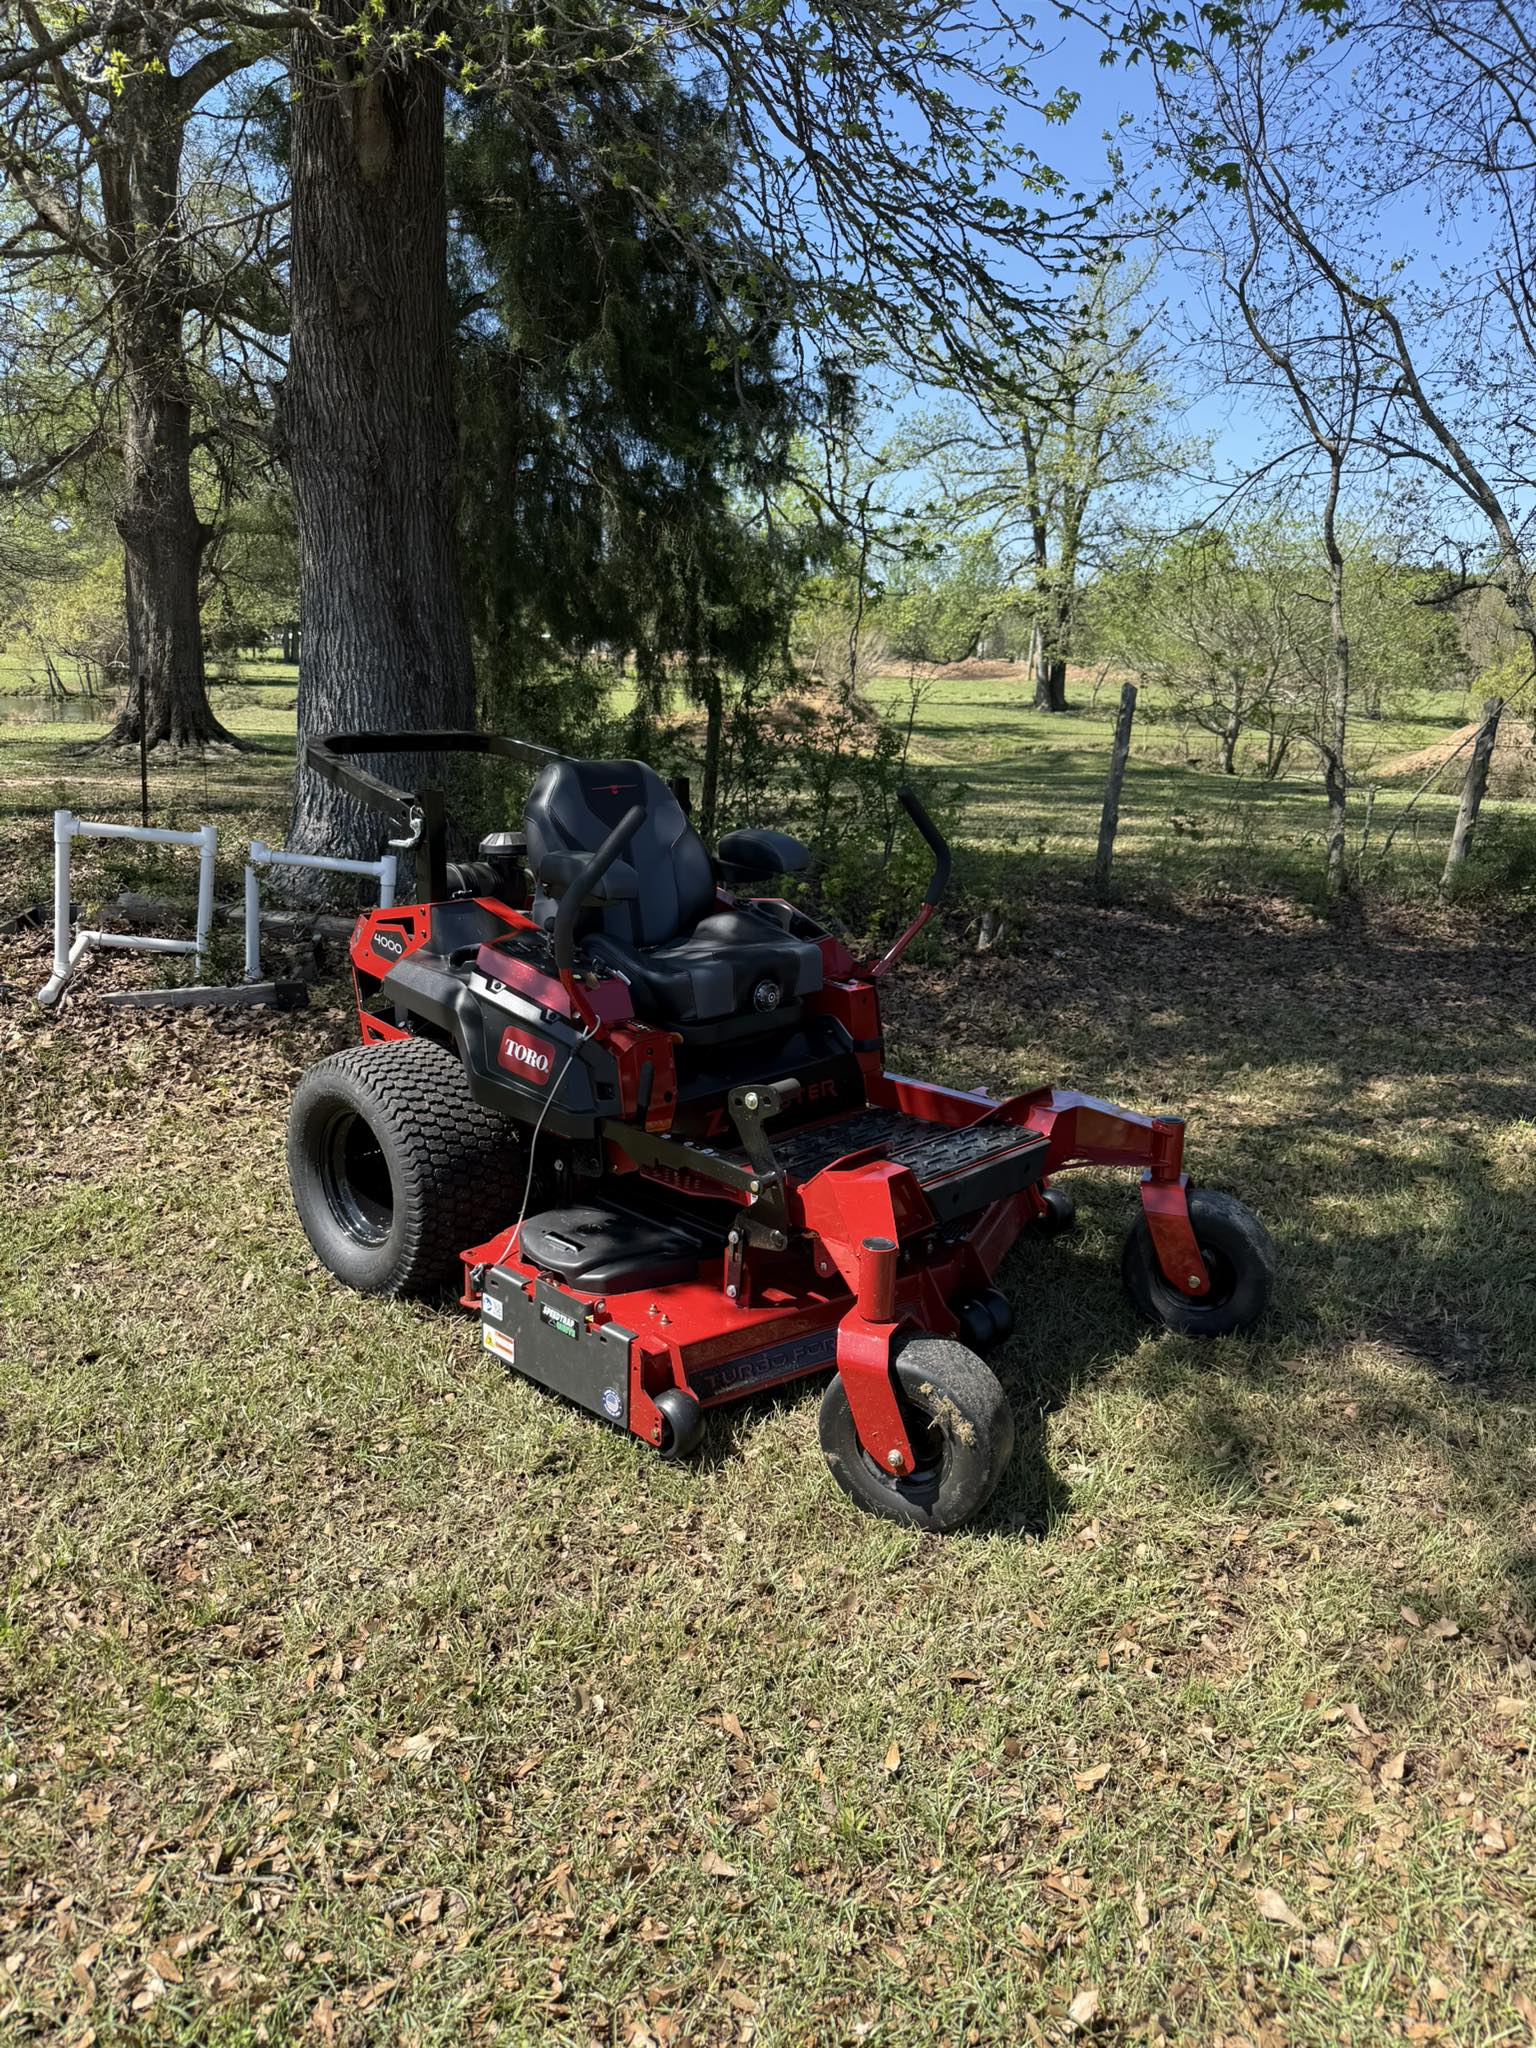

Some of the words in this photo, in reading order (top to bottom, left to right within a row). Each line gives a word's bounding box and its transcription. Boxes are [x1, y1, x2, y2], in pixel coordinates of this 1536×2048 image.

[374, 933, 403, 954] 4000
[505, 1038, 549, 1071] TORO
[794, 1336, 838, 1363] FOR
